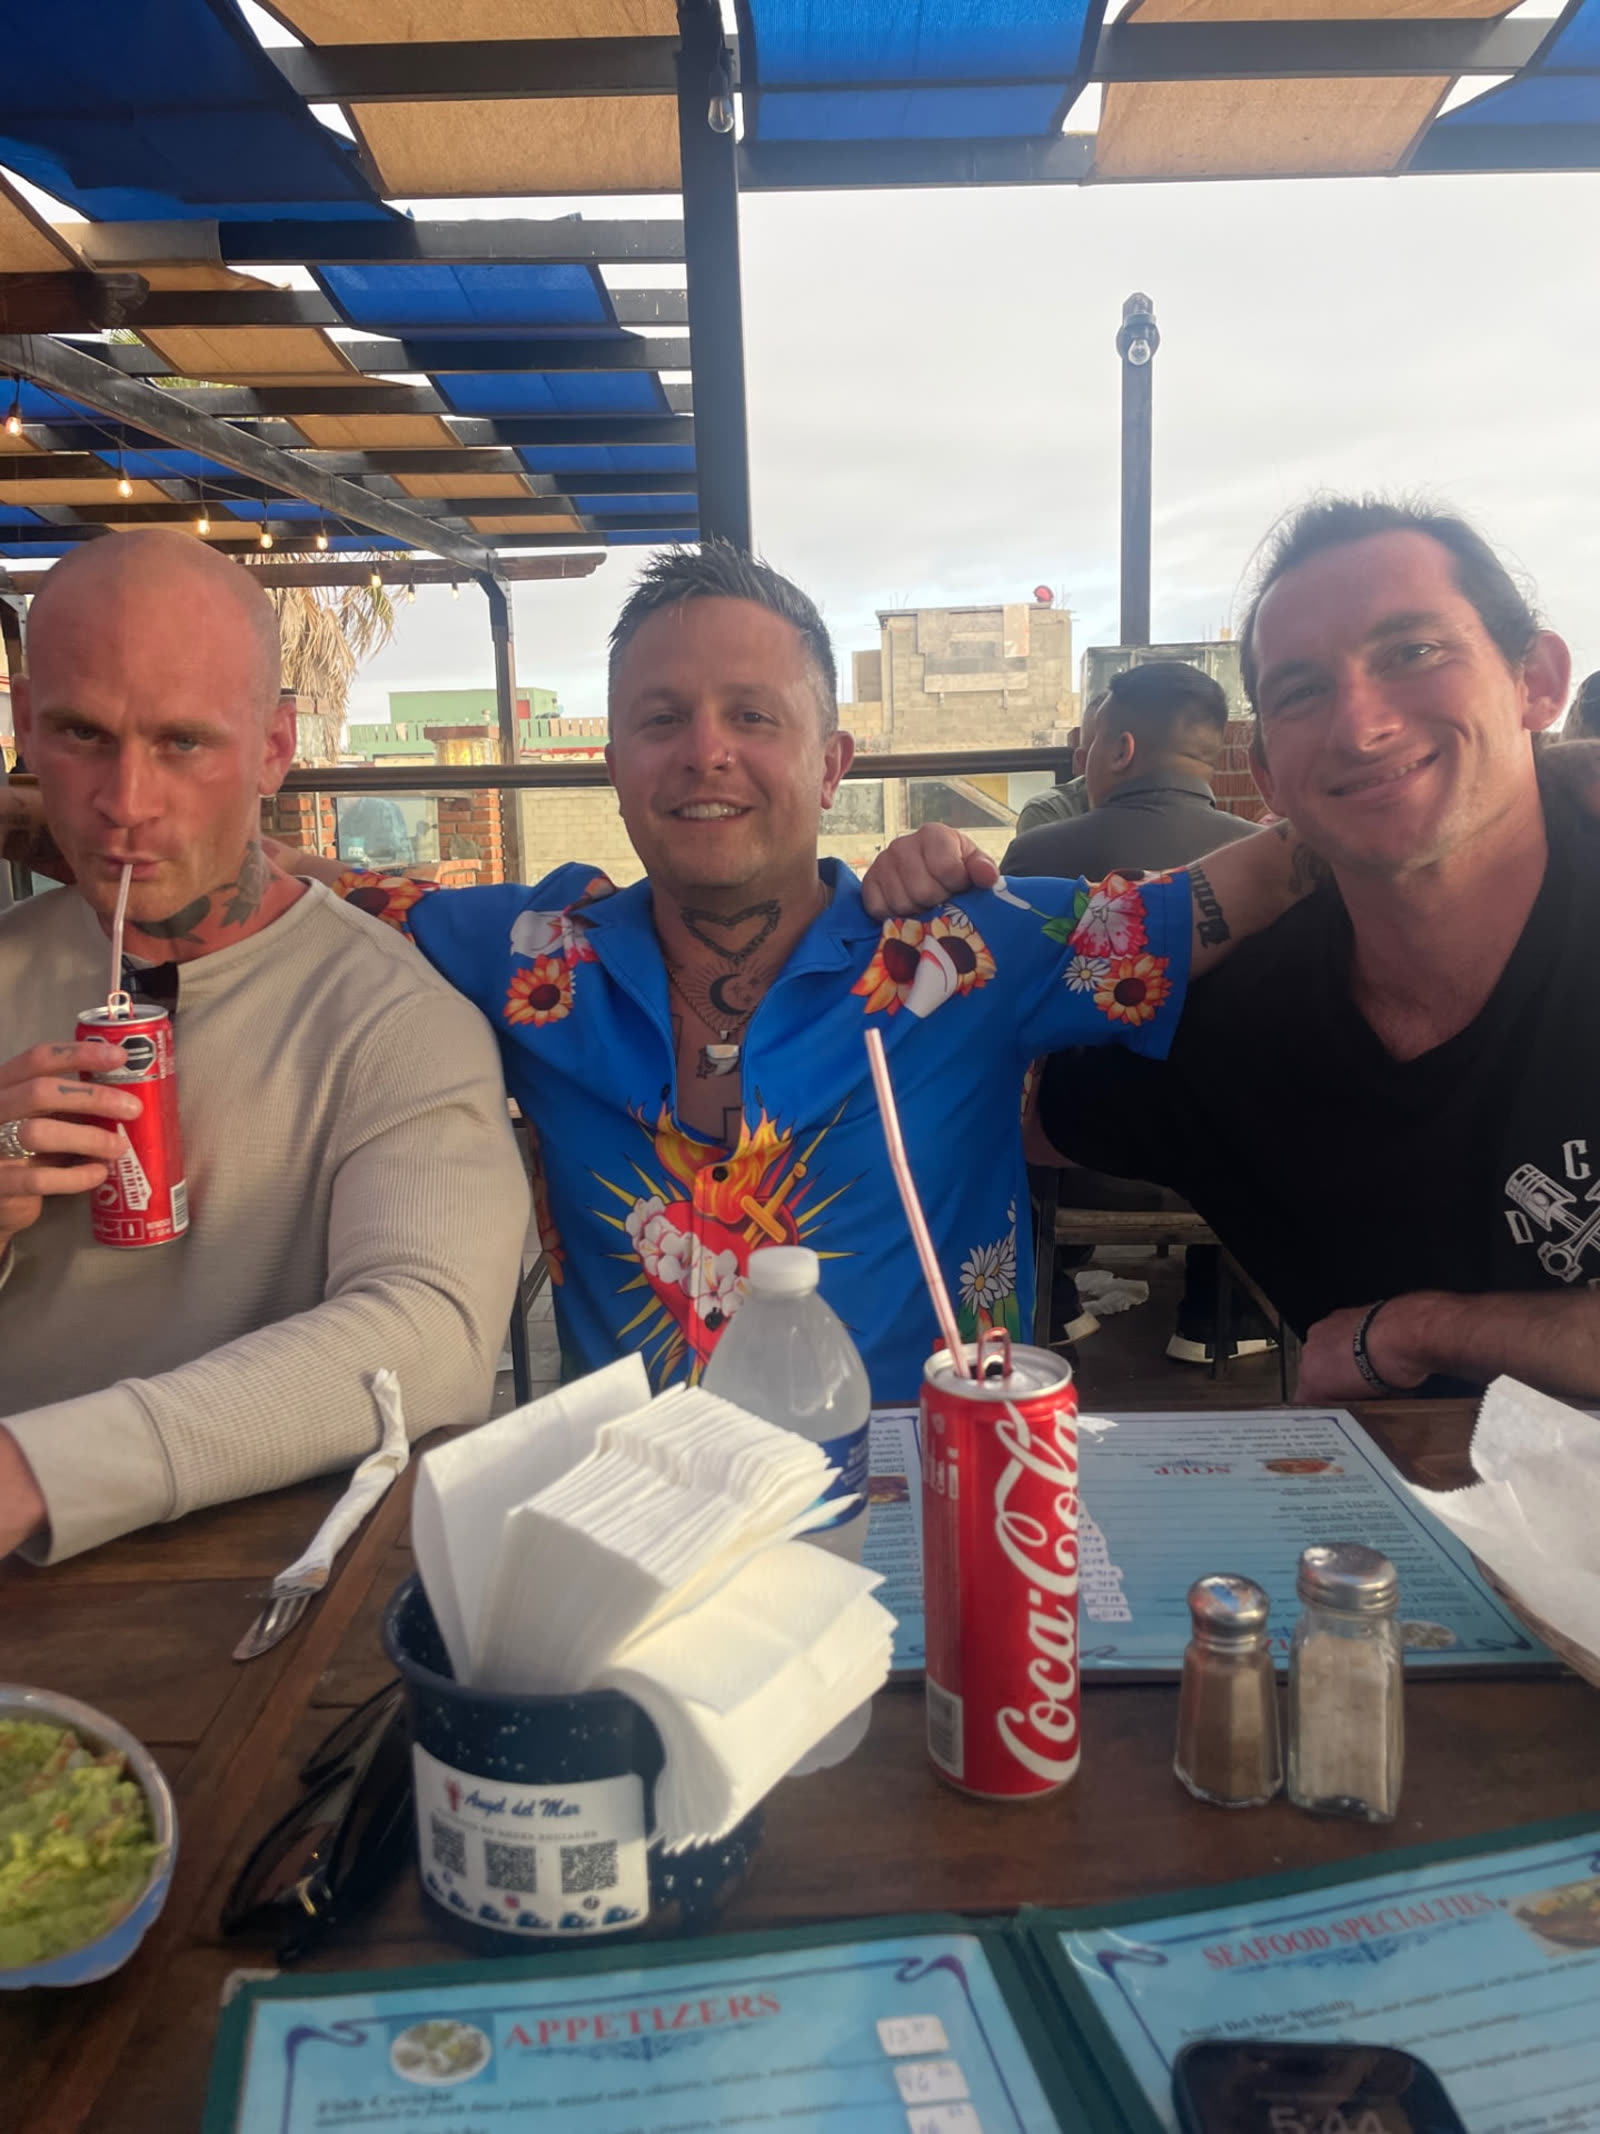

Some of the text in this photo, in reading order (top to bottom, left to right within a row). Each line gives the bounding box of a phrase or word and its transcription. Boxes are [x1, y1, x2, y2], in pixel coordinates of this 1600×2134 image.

[995, 1400, 1081, 1782] Coca-Cola
[1202, 1890, 1497, 1971] SEAFOOD SPECIALTIES
[504, 1992, 781, 2049] APPETIZERS
